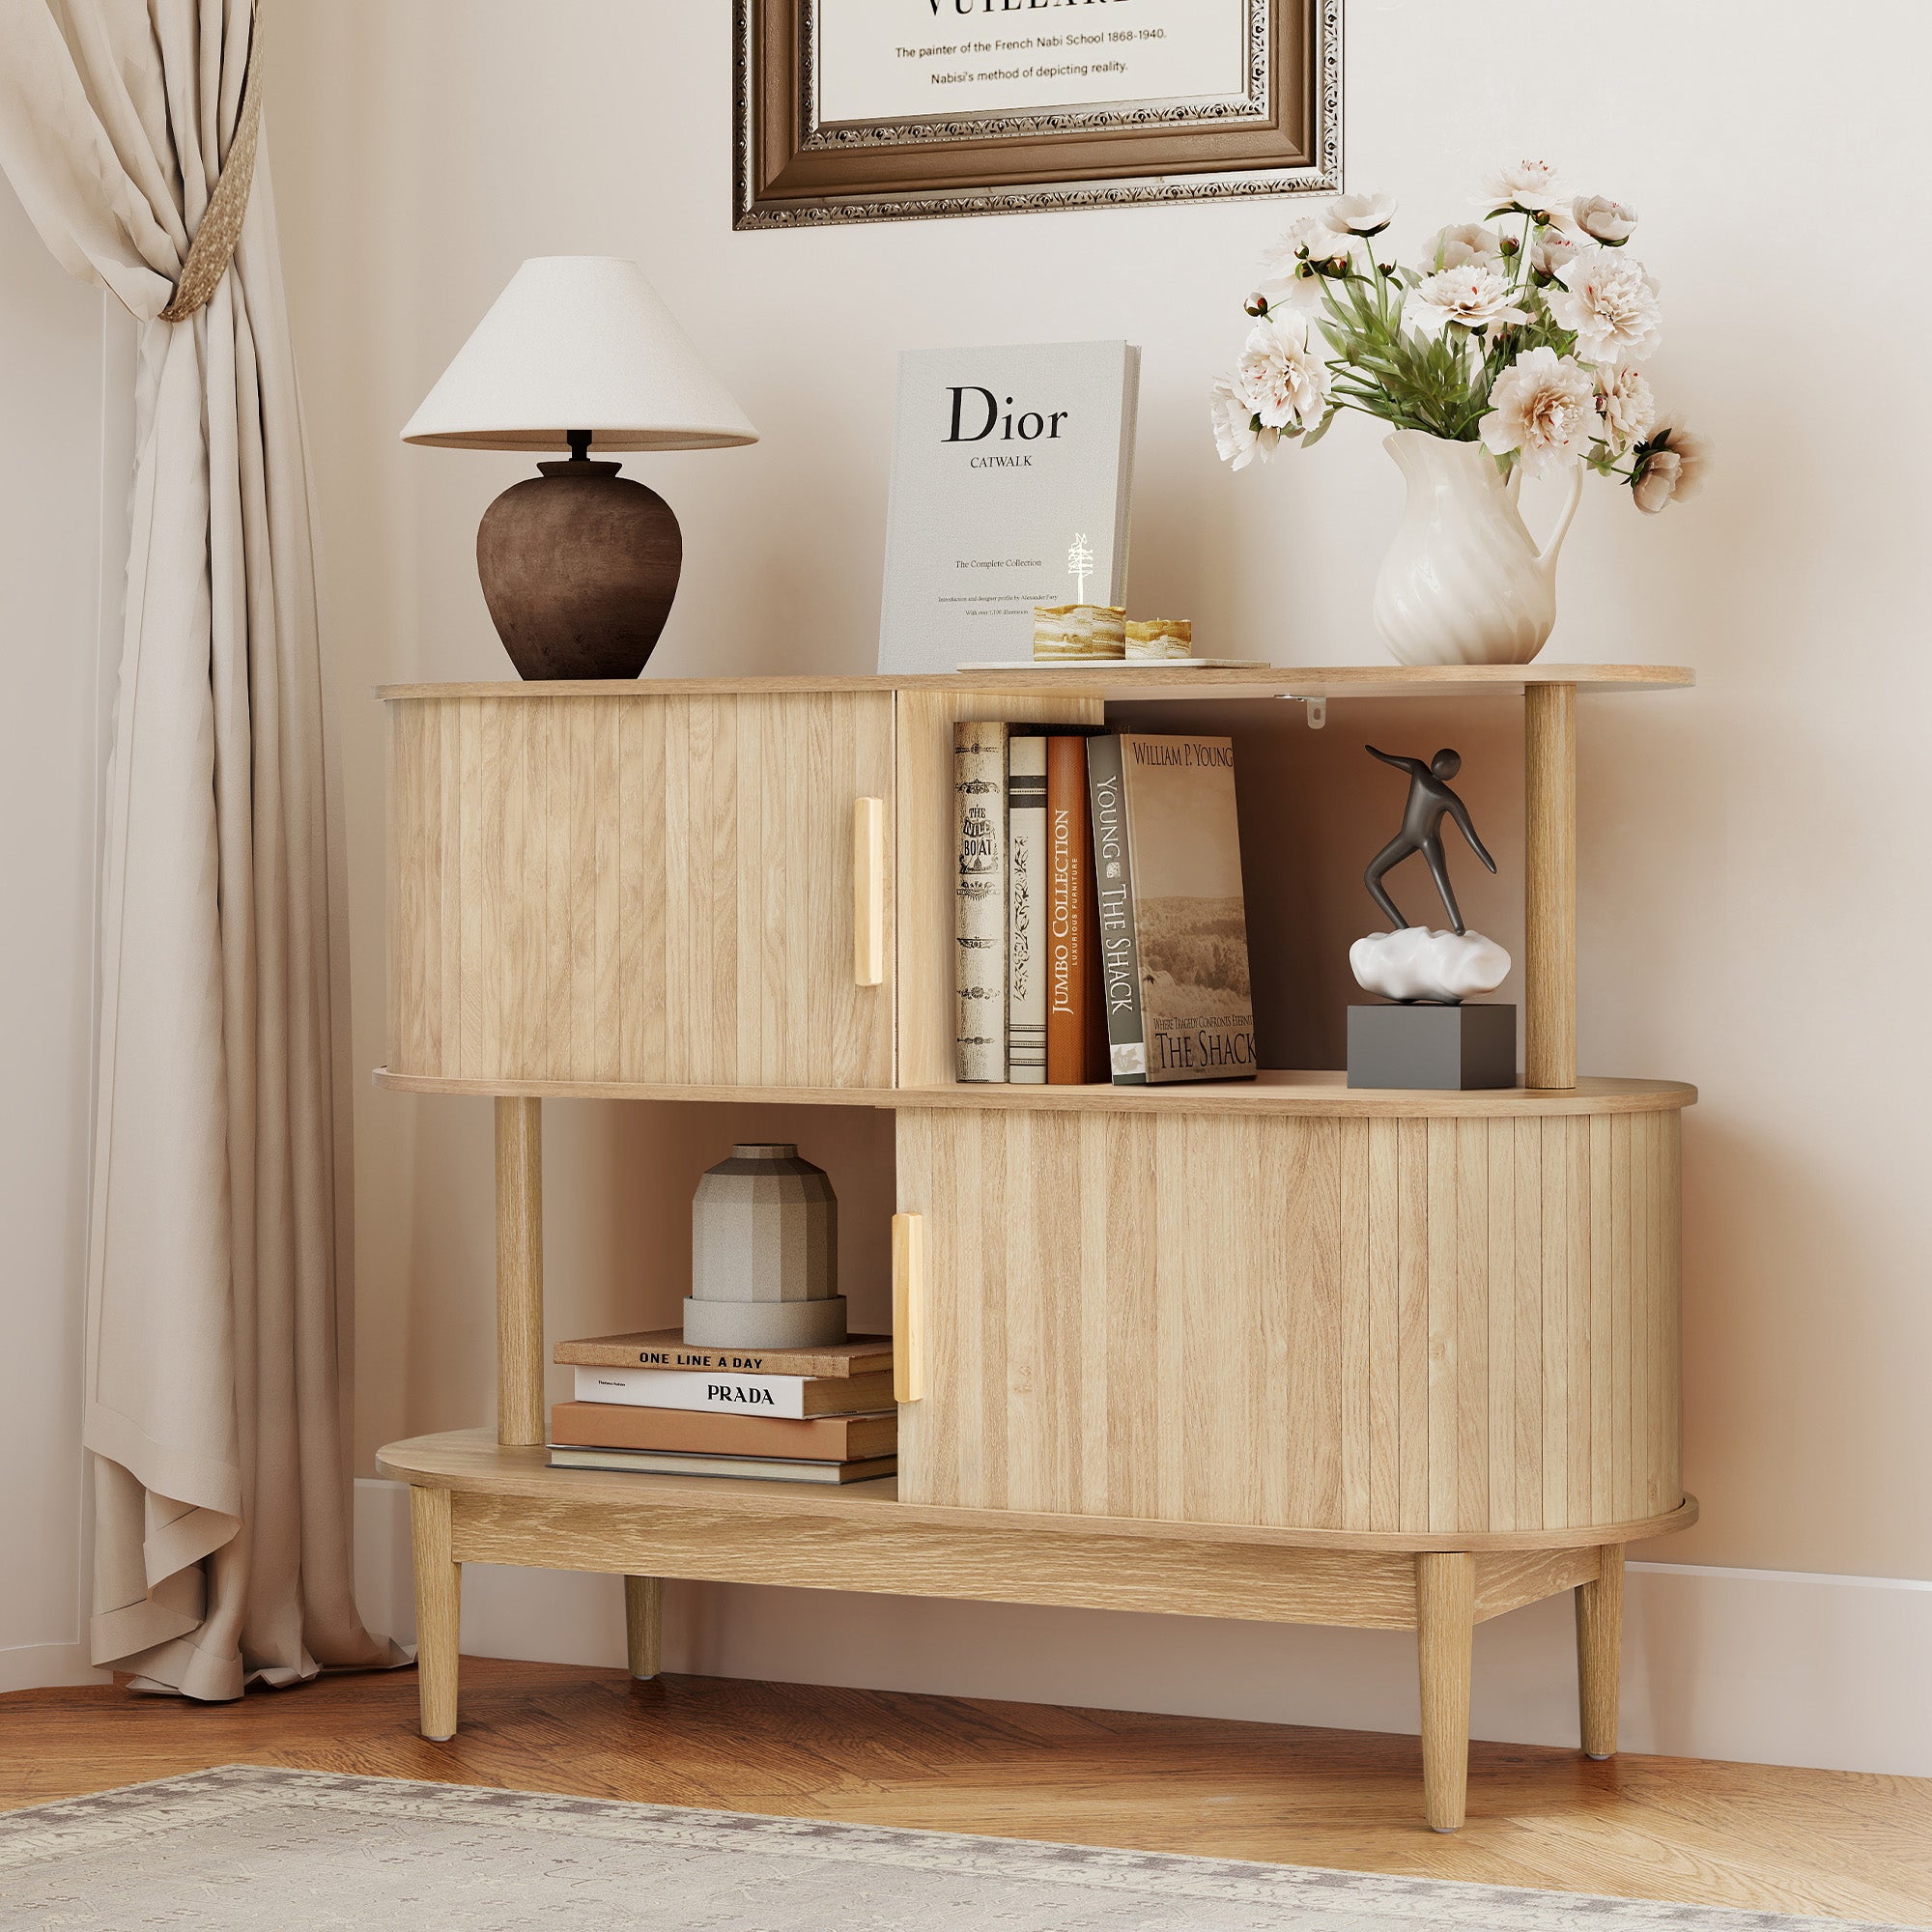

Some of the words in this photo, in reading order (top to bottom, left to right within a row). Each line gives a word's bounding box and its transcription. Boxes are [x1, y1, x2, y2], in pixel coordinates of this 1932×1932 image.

[895, 47, 916, 58] The
[919, 44, 957, 59] painter
[959, 42, 972, 54] of
[974, 42, 992, 52] the
[995, 39, 1033, 51] French
[1037, 35, 1063, 47] Nabi
[1065, 33, 1104, 45] School
[1108, 28, 1167, 42] 1868-1940.
[931, 71, 974, 84] Nabisi's
[977, 68, 1019, 81] method
[1022, 67, 1034, 78] of
[1036, 63, 1088, 78] depicting
[1091, 60, 1128, 74] reality.
[941, 386, 1068, 442] Dior
[970, 455, 1033, 469] CATWALK
[955, 560, 969, 569] The
[970, 559, 1004, 570] Complete
[1006, 558, 1041, 568] Collection
[1132, 742, 1182, 766] WILLIAM
[1184, 743, 1192, 766] P.
[1193, 744, 1234, 767] YOUNG
[1097, 776, 1121, 860] YOUNG
[964, 838, 993, 856] BOAT
[1052, 810, 1069, 938] COLLECTION
[1102, 883, 1127, 931] THE
[1052, 945, 1074, 1014] JUMBO
[1106, 938, 1133, 1015] SHACK
[1153, 1018, 1174, 1031] WHERE
[1199, 1015, 1232, 1029] CONFRONTS
[1155, 1033, 1194, 1069] THE
[1199, 1030, 1256, 1067] SHACK
[639, 1352, 669, 1364] ONE
[677, 1354, 712, 1367] LINE
[718, 1356, 727, 1367] A
[732, 1357, 762, 1369] DAY
[707, 1384, 775, 1406] PRADA
